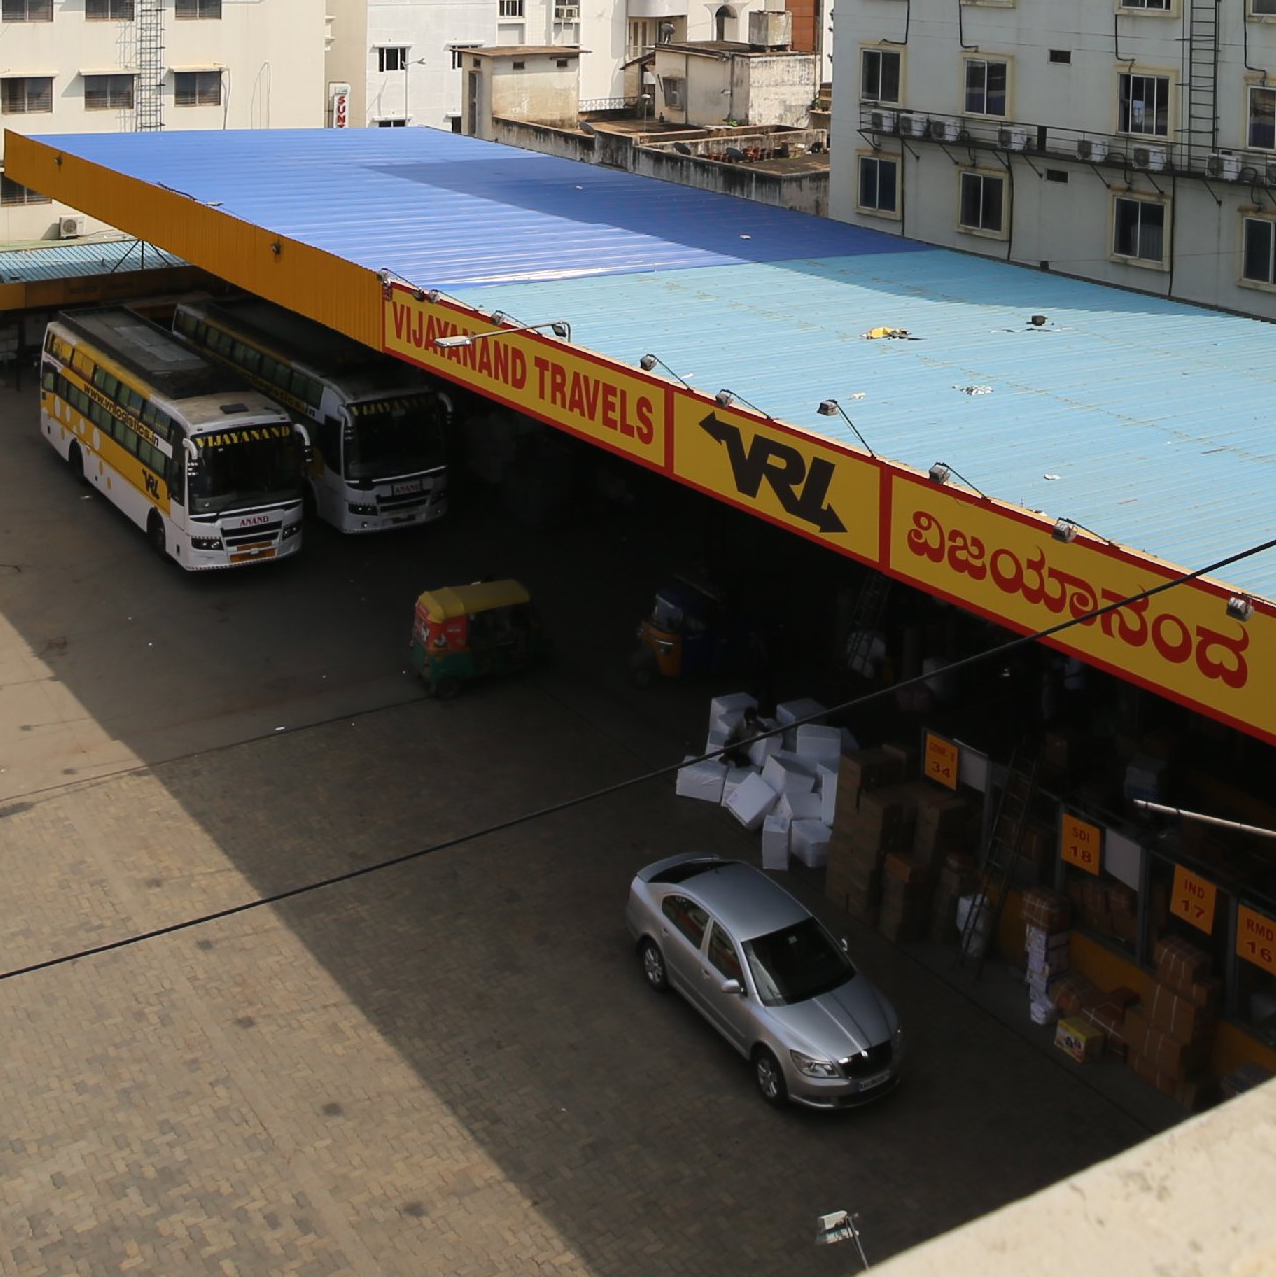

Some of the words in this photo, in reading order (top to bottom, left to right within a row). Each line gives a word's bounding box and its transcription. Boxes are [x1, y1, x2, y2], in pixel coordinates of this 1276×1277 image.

[392, 301, 526, 391] VIJAYANAND
[534, 358, 654, 446] TRAVELS
[351, 394, 436, 416] VIJAYANAND
[195, 425, 291, 449] VIJAYANAND
[142, 467, 161, 500] VRL
[698, 411, 847, 534] VRL
[239, 515, 269, 527] ANAND
[907, 510, 1250, 689] ವಿಜಯಾನಂದ
[931, 760, 950, 778] 34
[1069, 846, 1092, 863] 18
[1183, 879, 1205, 900] IND
[1180, 899, 1206, 919] 17
[1246, 917, 1275, 942] RMD
[1245, 941, 1273, 964] 16
